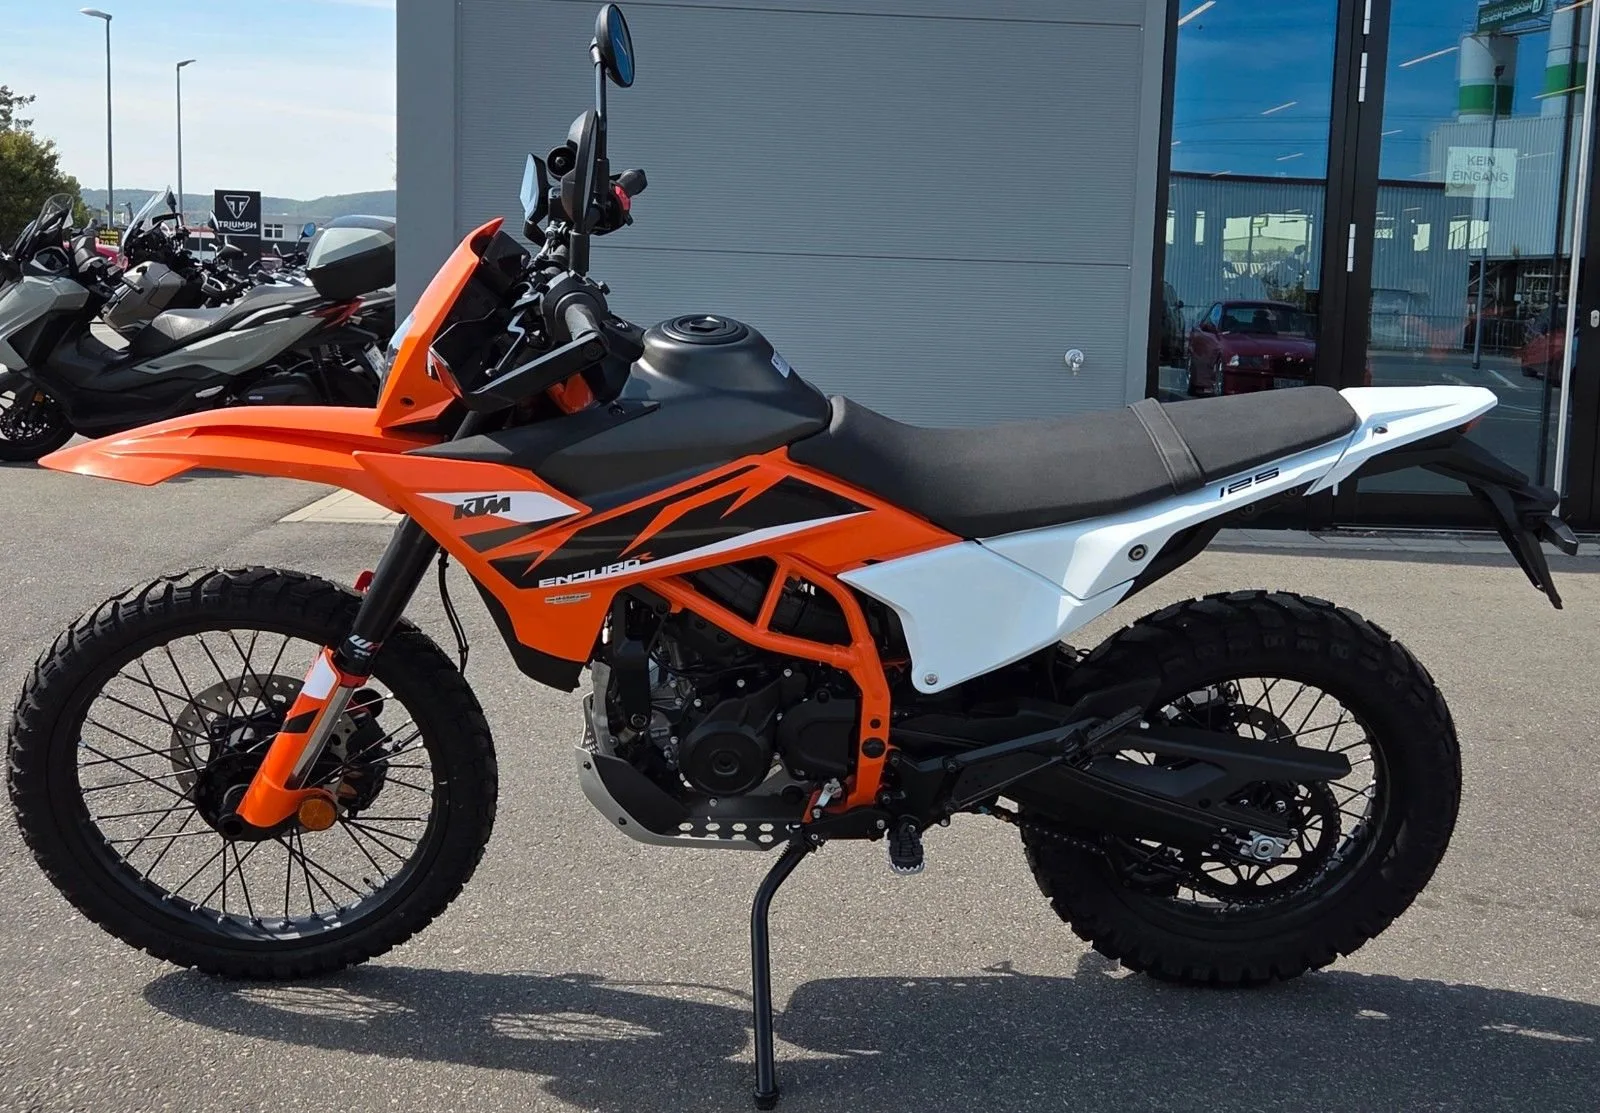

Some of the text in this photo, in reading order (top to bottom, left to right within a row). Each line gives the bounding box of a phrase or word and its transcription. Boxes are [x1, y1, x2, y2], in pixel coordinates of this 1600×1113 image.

[1467, 155, 1496, 167] KEIN
[1452, 171, 1509, 183] EINGANG
[219, 221, 257, 229] TRIUMPH
[1219, 467, 1280, 498] 125
[453, 495, 511, 520] KTM
[538, 559, 641, 588] ENDURO
